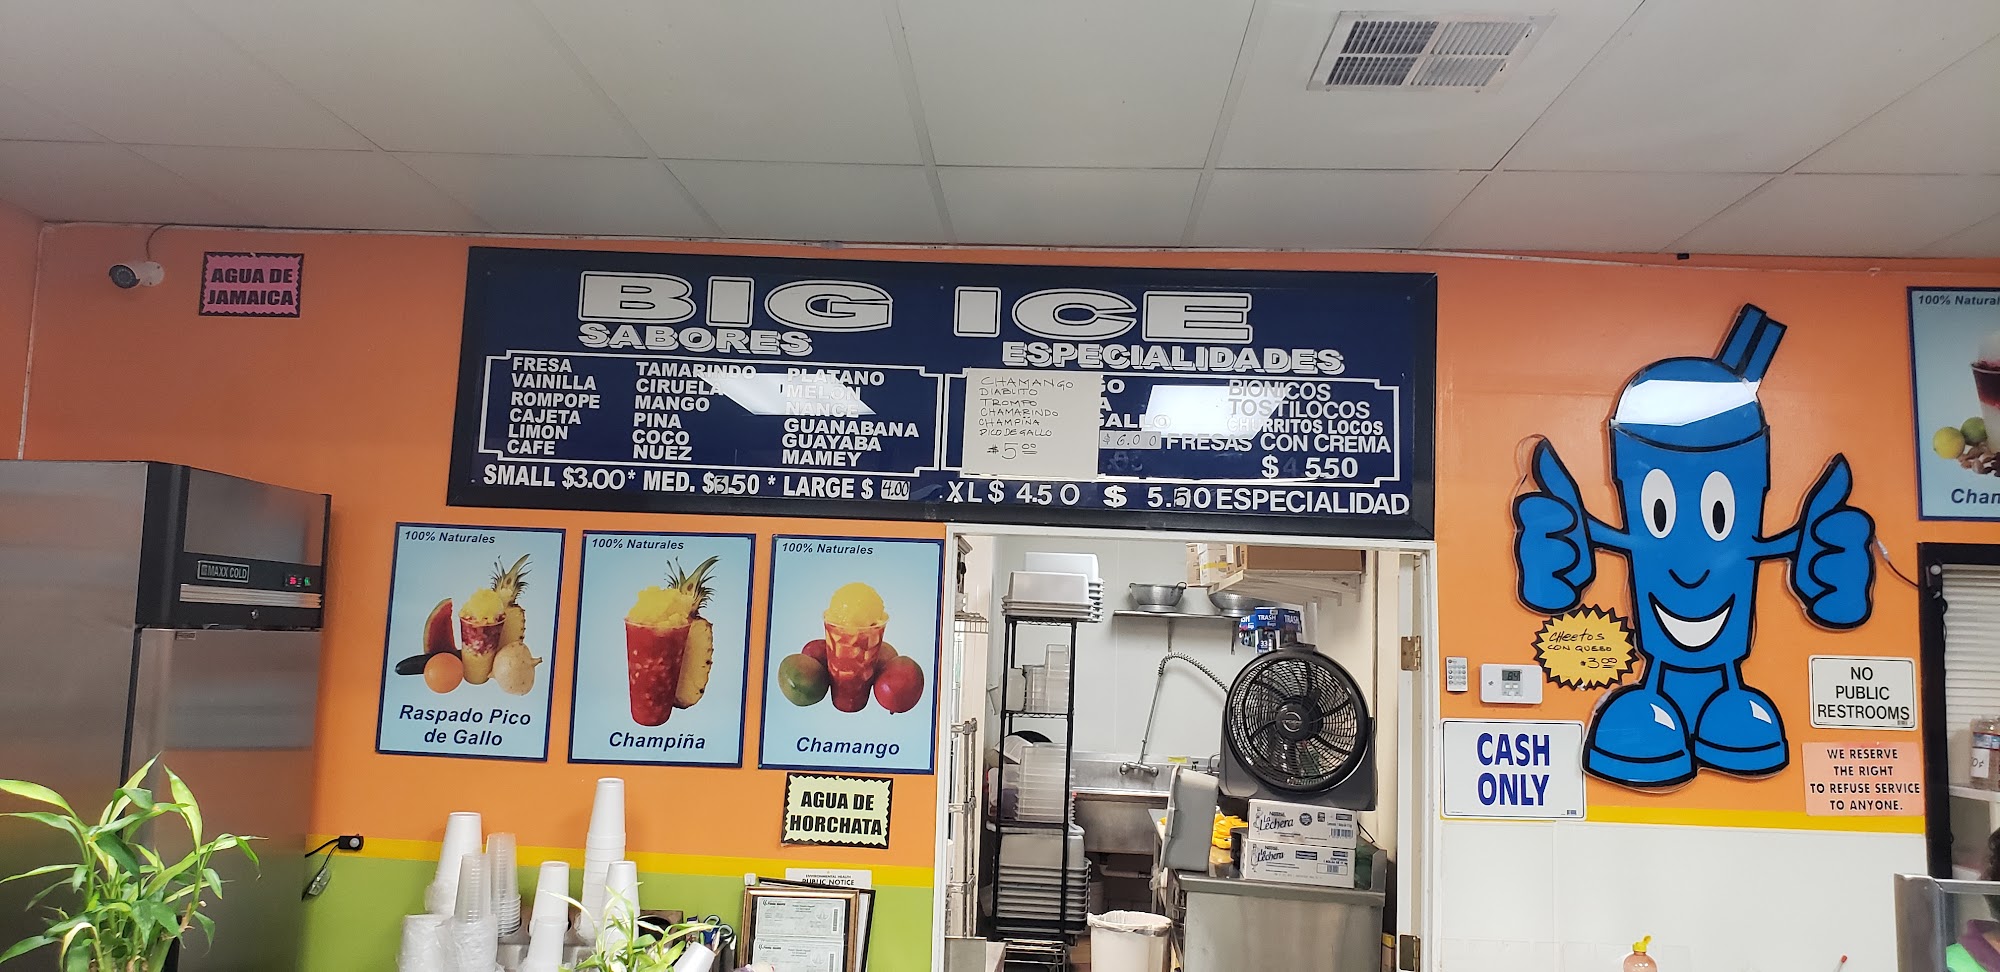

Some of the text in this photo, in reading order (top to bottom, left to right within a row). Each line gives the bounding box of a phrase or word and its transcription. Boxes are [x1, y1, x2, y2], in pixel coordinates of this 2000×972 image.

[211, 268, 293, 283] AGUA DE
[207, 290, 293, 305] JAMAICA
[1919, 295, 1951, 305] 100%
[578, 271, 1253, 343] BIG ICE
[578, 323, 813, 356] SABORES
[513, 357, 572, 372] FRESA
[1002, 341, 1347, 375] ESPECIALIDADES
[636, 362, 757, 379] TAMARINDO
[787, 367, 884, 386] PLATANO
[511, 373, 596, 390] VAINILLA
[636, 378, 723, 395] CIRUELA
[981, 377, 1074, 390] CHAMANGO
[786, 384, 861, 401] MELON
[979, 388, 1038, 396] DIABLITO
[1229, 380, 1331, 401] BIONICOS
[510, 391, 600, 409] ROMPOPE
[635, 395, 710, 412] MANGO
[980, 398, 1037, 407] TROMPO
[509, 408, 581, 424] CAJETA
[785, 402, 859, 418] NANCE
[980, 408, 1059, 417] CHAMARINDO
[1228, 399, 1370, 419] TOSTILOCOS
[633, 412, 681, 428] PINA
[784, 418, 919, 437] GUANABANA
[1227, 417, 1384, 436] CHURRITOS LOCOS
[508, 424, 568, 440] LIMON
[632, 429, 690, 446] COCO
[979, 428, 1052, 437] PICO DE GALLO
[507, 440, 555, 455] CAFE
[782, 434, 882, 451] GUAYABA
[1166, 433, 1391, 453] FRESAS CON CREMA
[633, 444, 692, 461] NUEZ
[782, 450, 862, 467] MAMEY
[484, 464, 555, 487] SMALL
[643, 471, 695, 492] MED.
[783, 475, 854, 498] LARGE
[1216, 488, 1410, 515] ESPECIALIDAD
[405, 531, 495, 544] 100% Naturales
[592, 538, 684, 549] 100% Naturales
[782, 543, 873, 555] 100% Naturales
[207, 565, 247, 579] MAXX COLD
[1851, 667, 1873, 681] NO
[1836, 686, 1890, 700] PUBLIC
[399, 704, 531, 725] Raspado Pico
[1818, 704, 1910, 720] RESTROOMS
[424, 728, 503, 746] de Gallo
[609, 731, 706, 752] Champiña
[796, 737, 900, 758] Chamango
[1477, 733, 1550, 766] CASH
[1827, 749, 1898, 759] WE RESERVE
[1834, 766, 1893, 776] THE RIGHT
[1477, 773, 1550, 806] ONLY
[1810, 783, 1920, 794] TO REFUSE SERVICE
[800, 791, 875, 811] AGUA DE
[1830, 800, 1903, 811] TO ANYONE.
[789, 814, 882, 836] HORCHATA
[1260, 818, 1294, 830] Lechera
